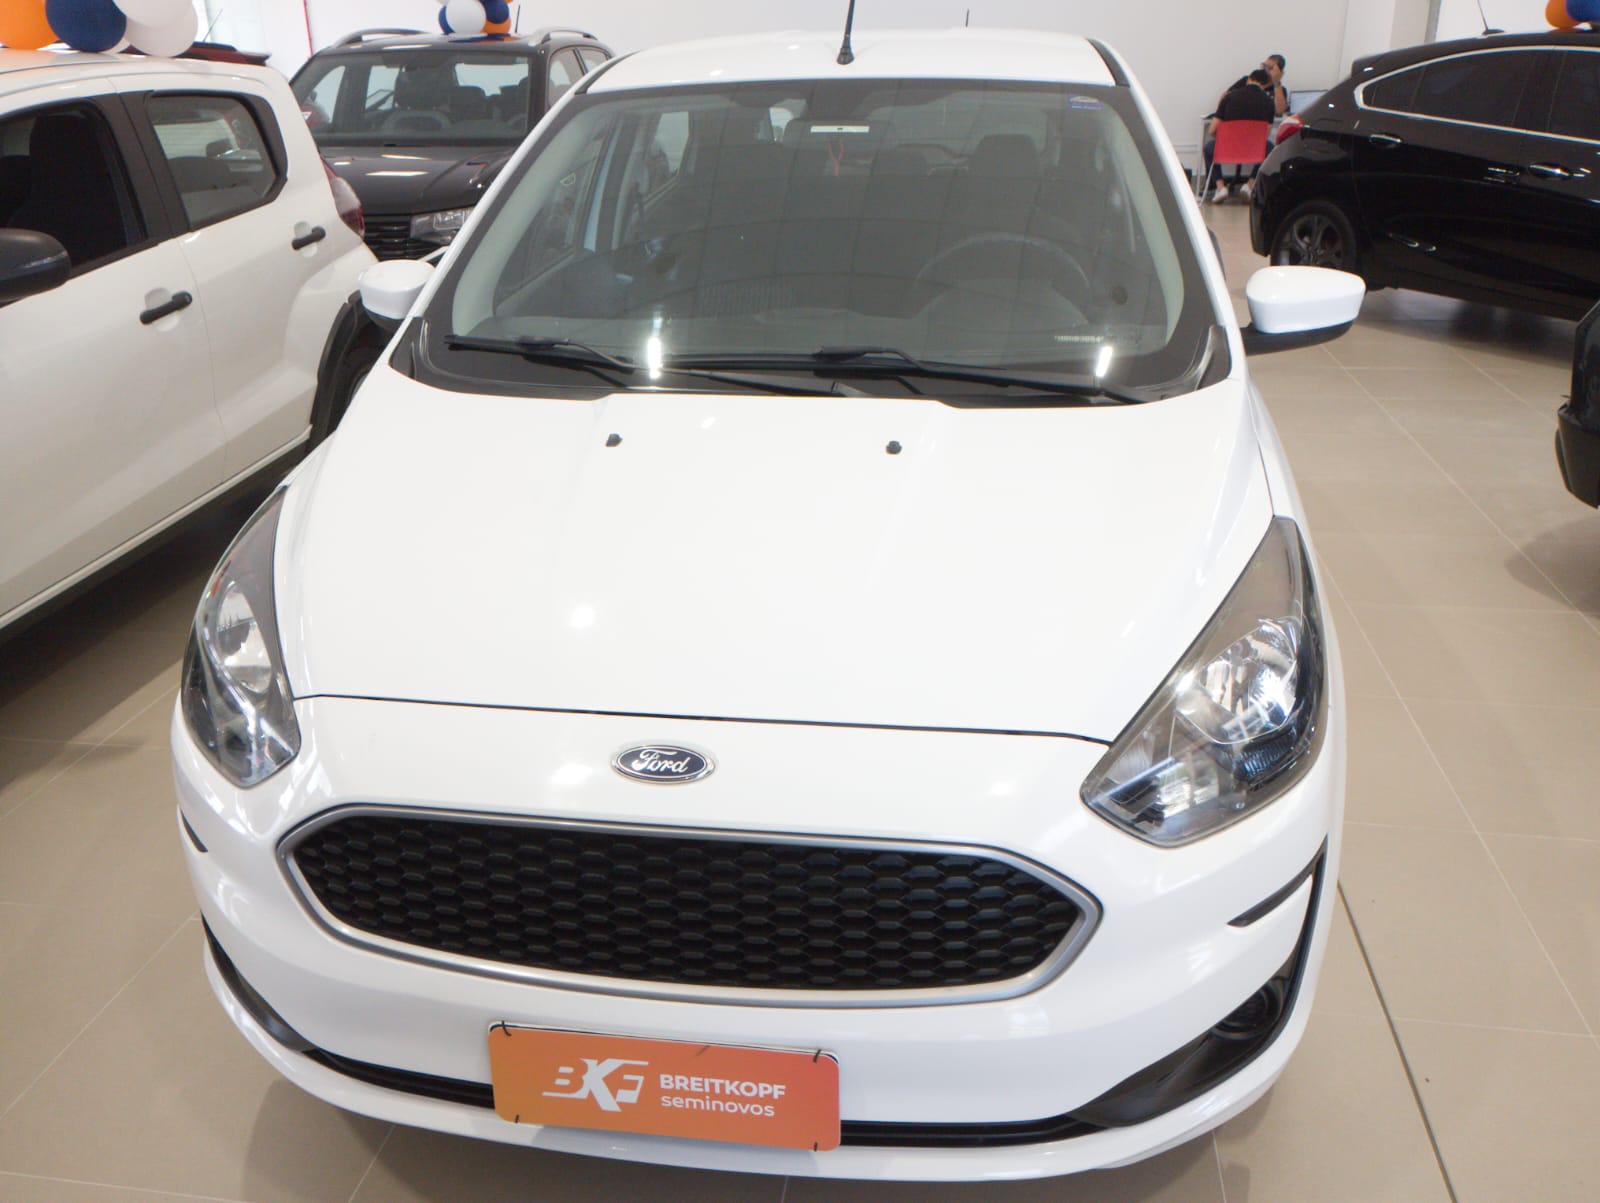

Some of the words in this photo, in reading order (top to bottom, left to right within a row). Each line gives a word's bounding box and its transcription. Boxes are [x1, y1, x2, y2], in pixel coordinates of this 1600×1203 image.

[631, 749, 691, 773] Ford
[659, 1073, 786, 1099] BREITKOPF
[660, 1094, 775, 1117] seminovos
